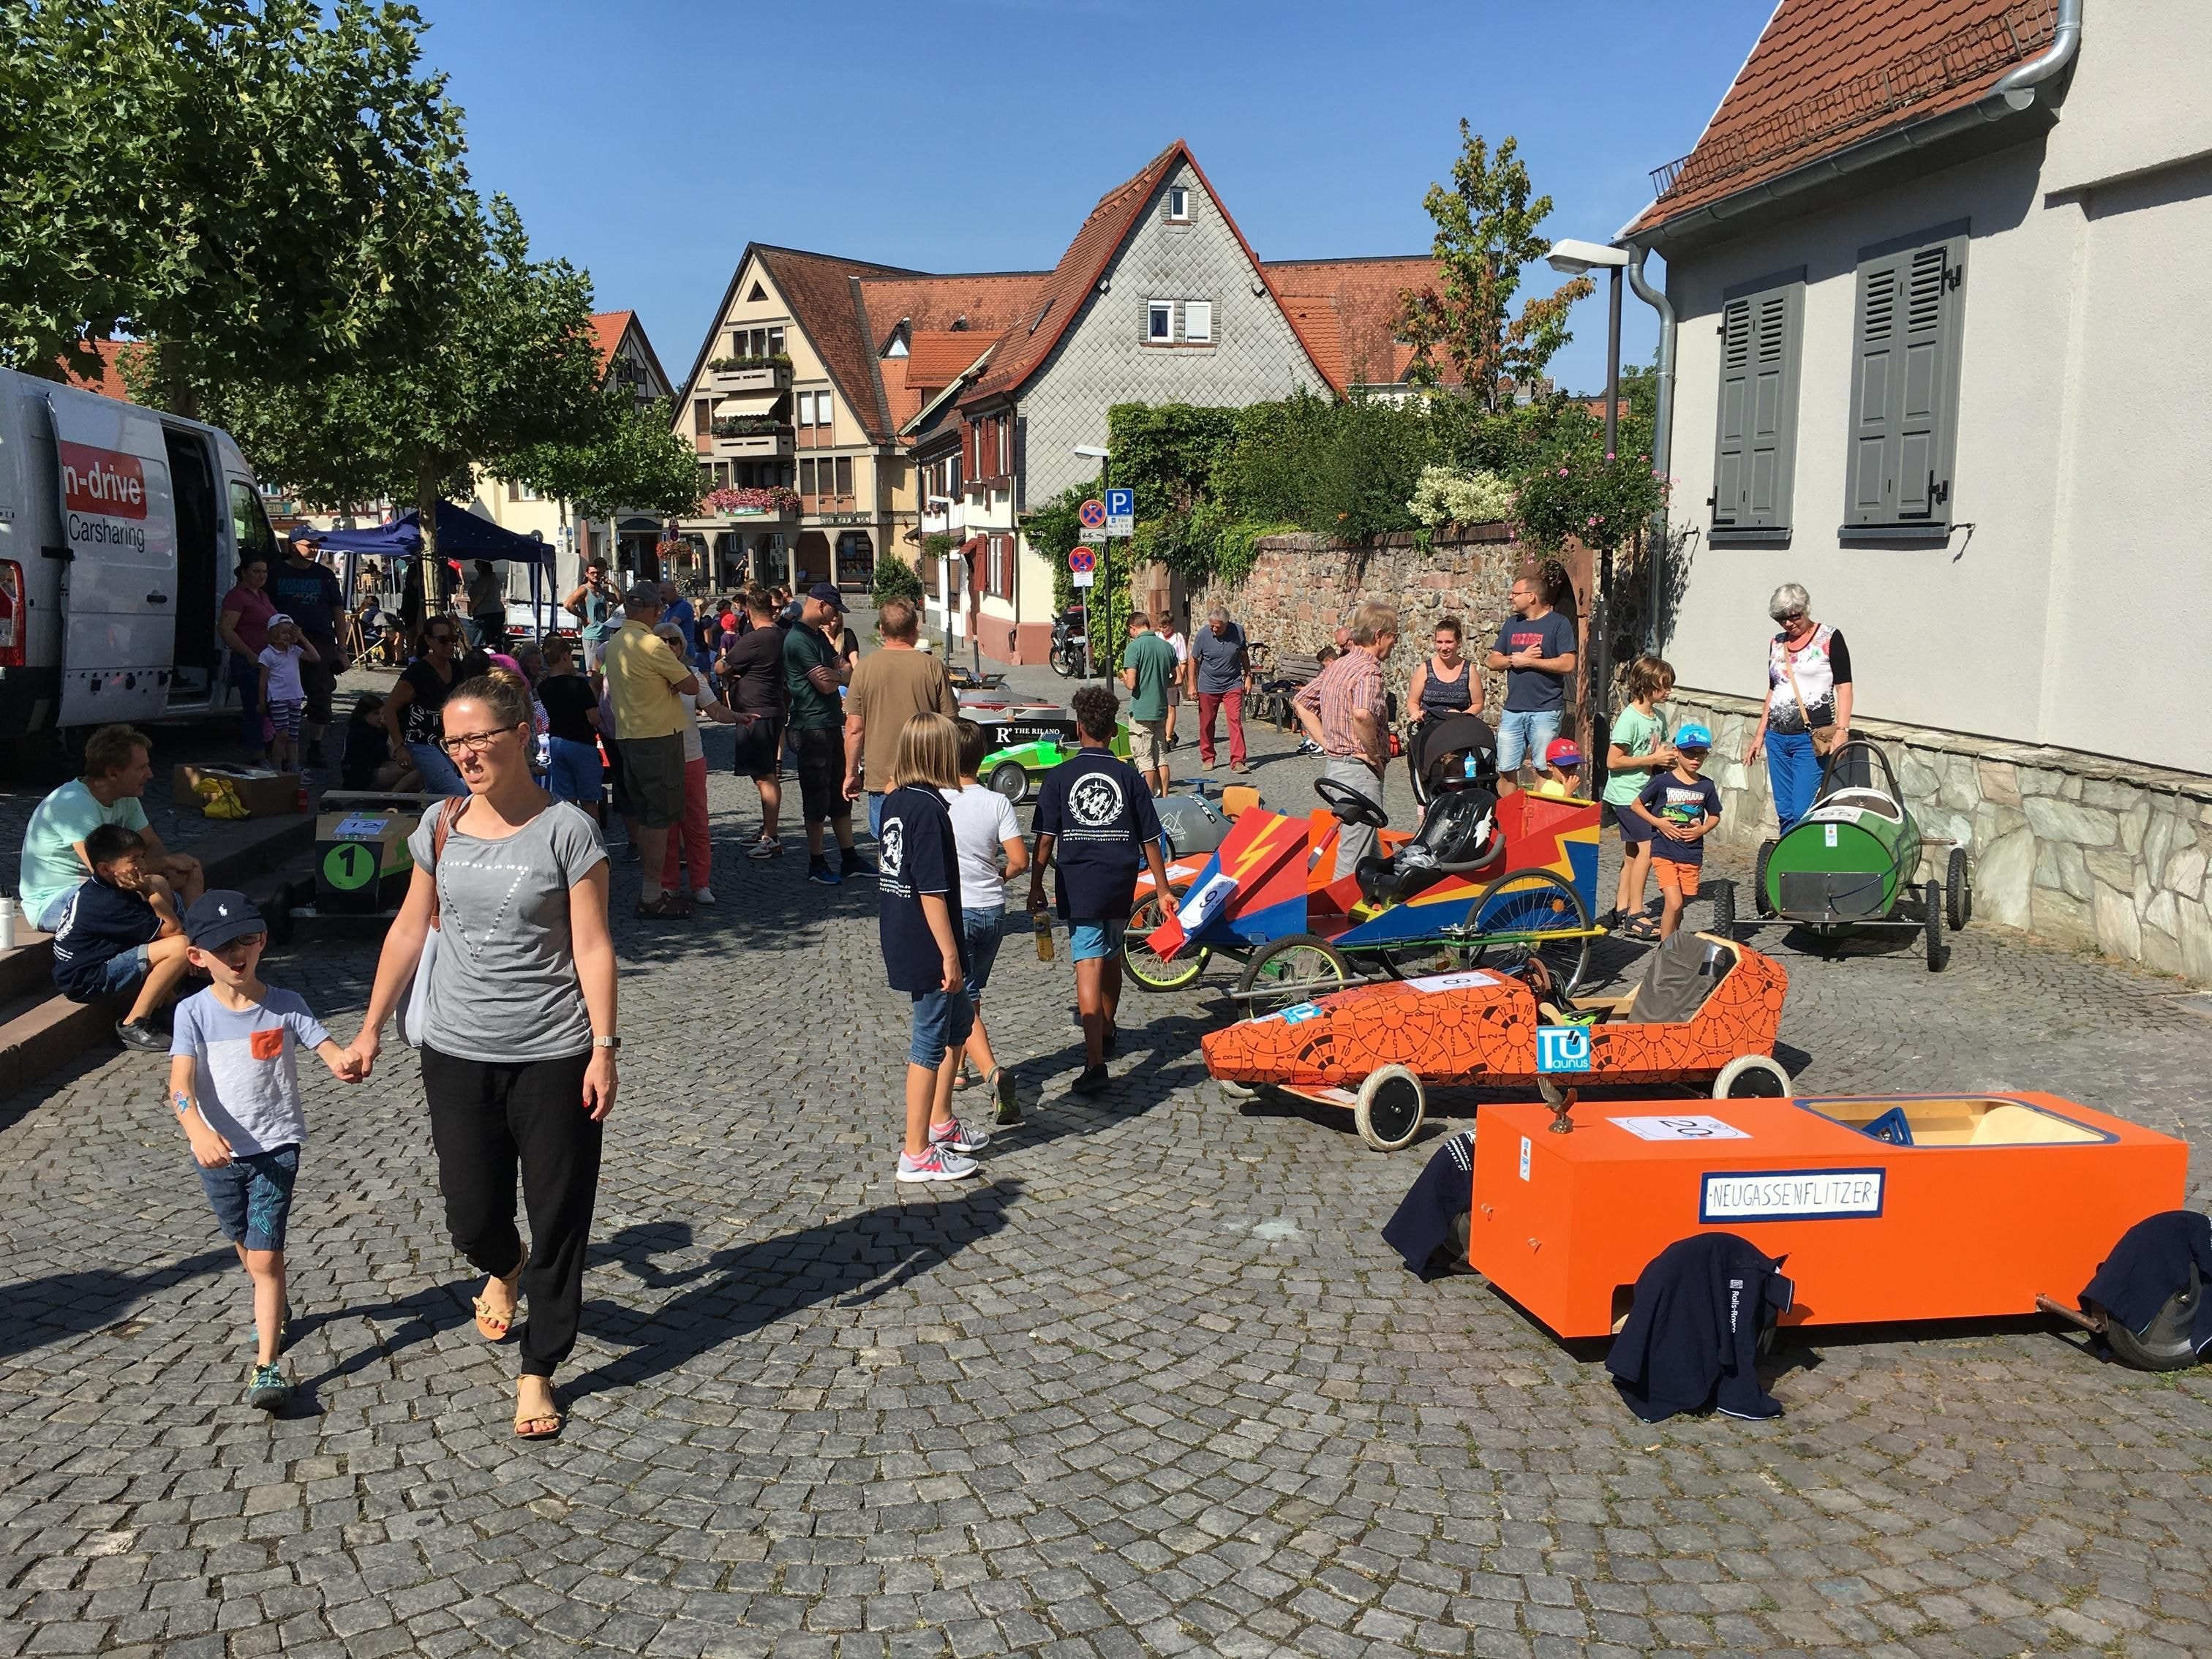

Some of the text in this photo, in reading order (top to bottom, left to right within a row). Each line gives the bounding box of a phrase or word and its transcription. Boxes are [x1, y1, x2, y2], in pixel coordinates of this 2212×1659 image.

[1113, 493, 1127, 514] P
[69, 514, 145, 553] Carsharing
[339, 846, 356, 877] 1
[1713, 1181, 1872, 1207] NEUGASSENFLITZER
